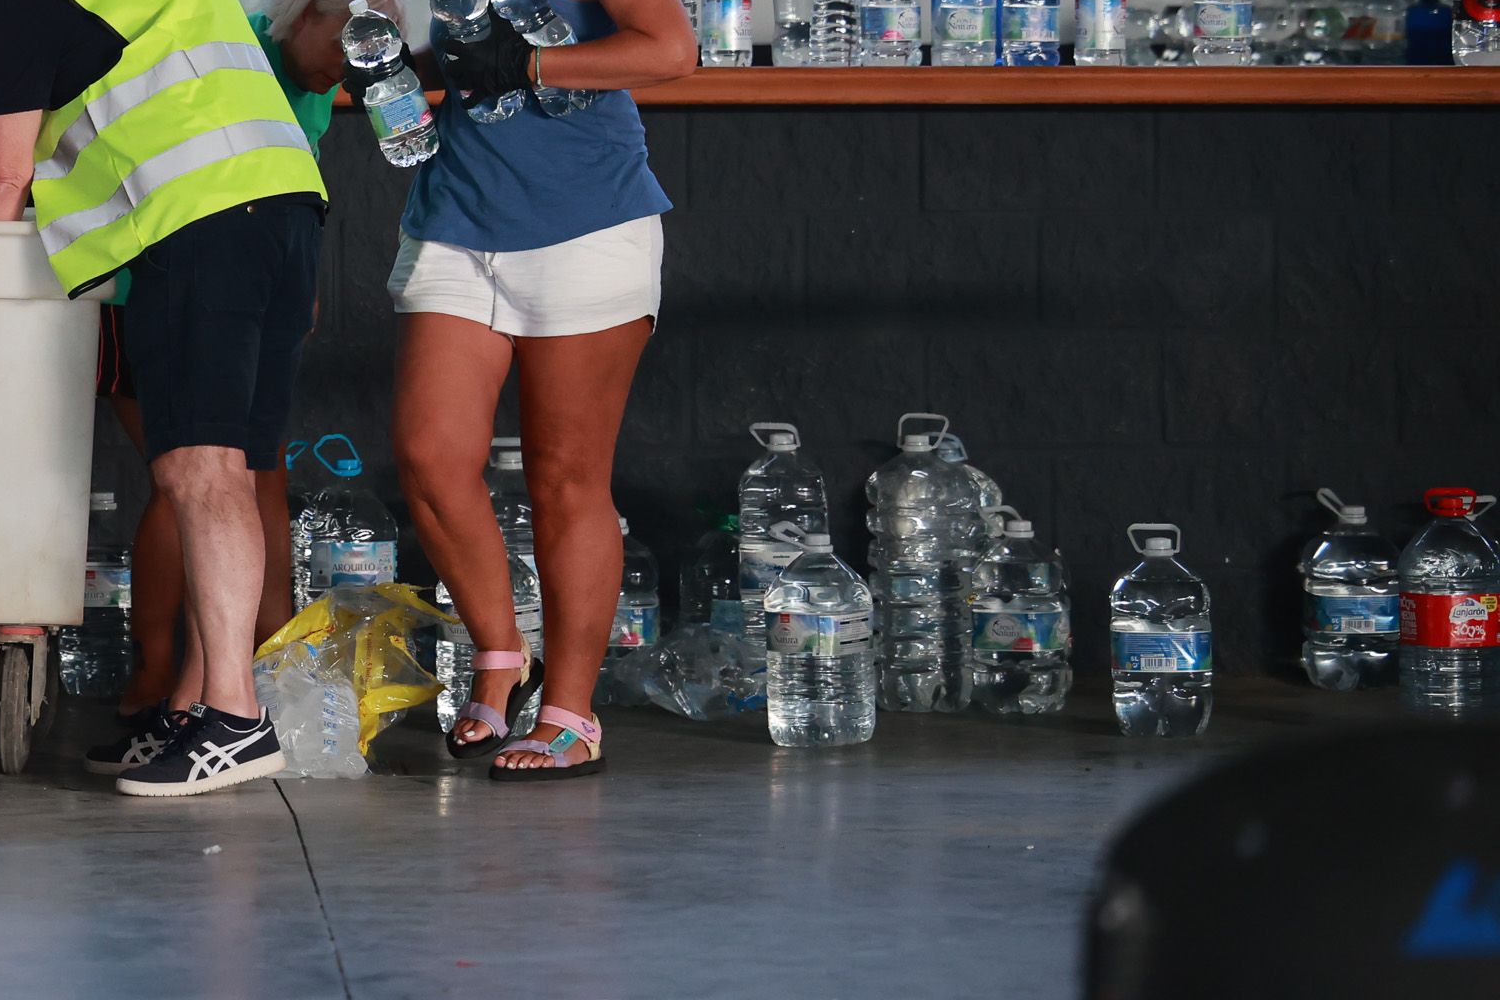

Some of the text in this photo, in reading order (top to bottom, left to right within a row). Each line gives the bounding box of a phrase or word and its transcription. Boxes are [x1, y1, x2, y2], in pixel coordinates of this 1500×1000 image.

[333, 562, 376, 572] ARQUILLO
[1453, 607, 1486, 618] Lanjarón
[323, 707, 336, 716] ICE
[323, 721, 338, 729] ICE
